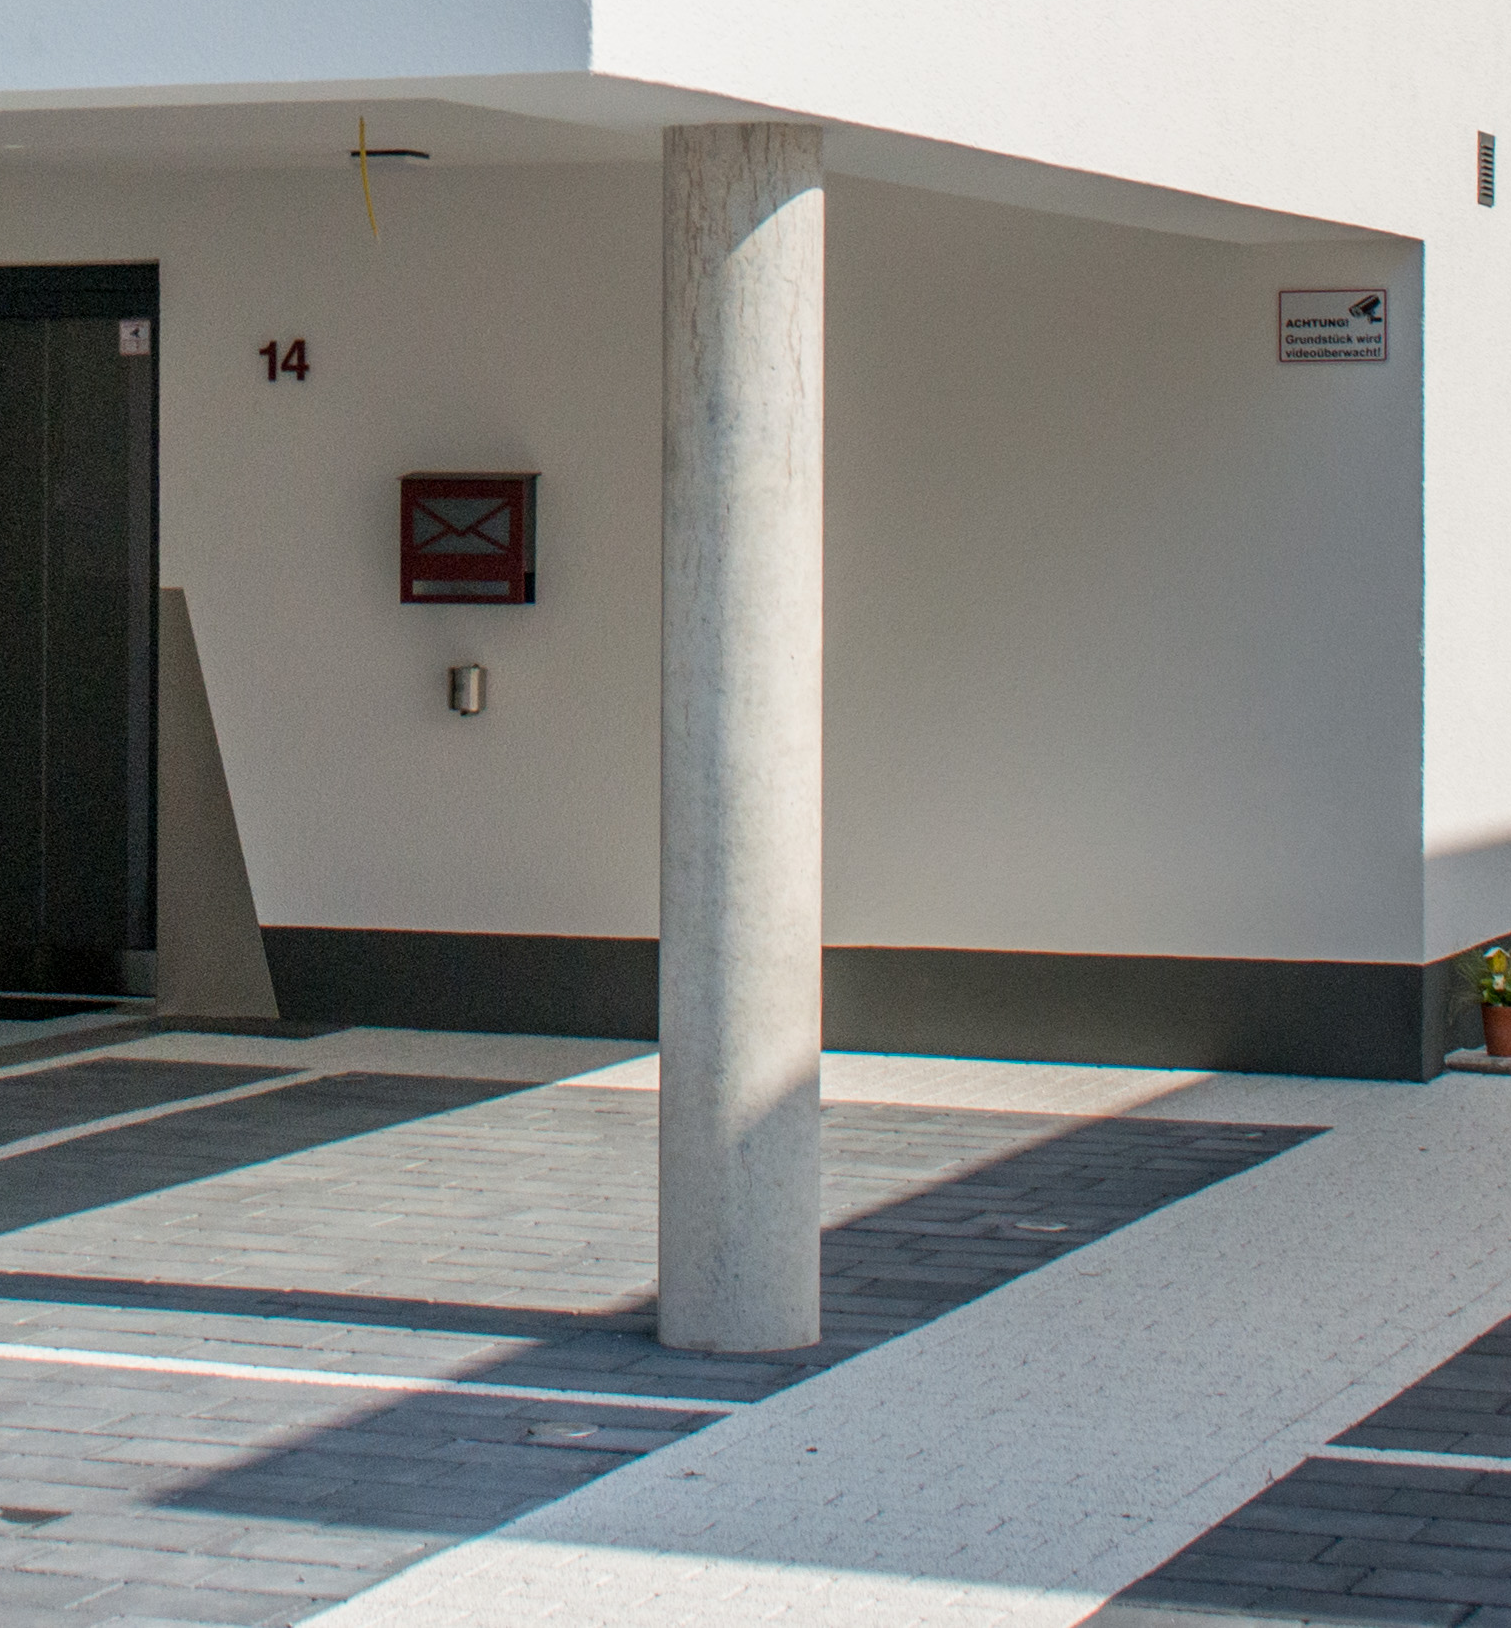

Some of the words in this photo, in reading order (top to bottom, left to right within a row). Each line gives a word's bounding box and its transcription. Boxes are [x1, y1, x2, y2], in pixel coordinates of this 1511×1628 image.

[1285, 318, 1349, 328] ACHTUNG!
[1285, 334, 1353, 345] Grundstück
[1356, 334, 1382, 344] wird
[1285, 347, 1382, 358] videoüberwacht!
[258, 339, 310, 383] 14
